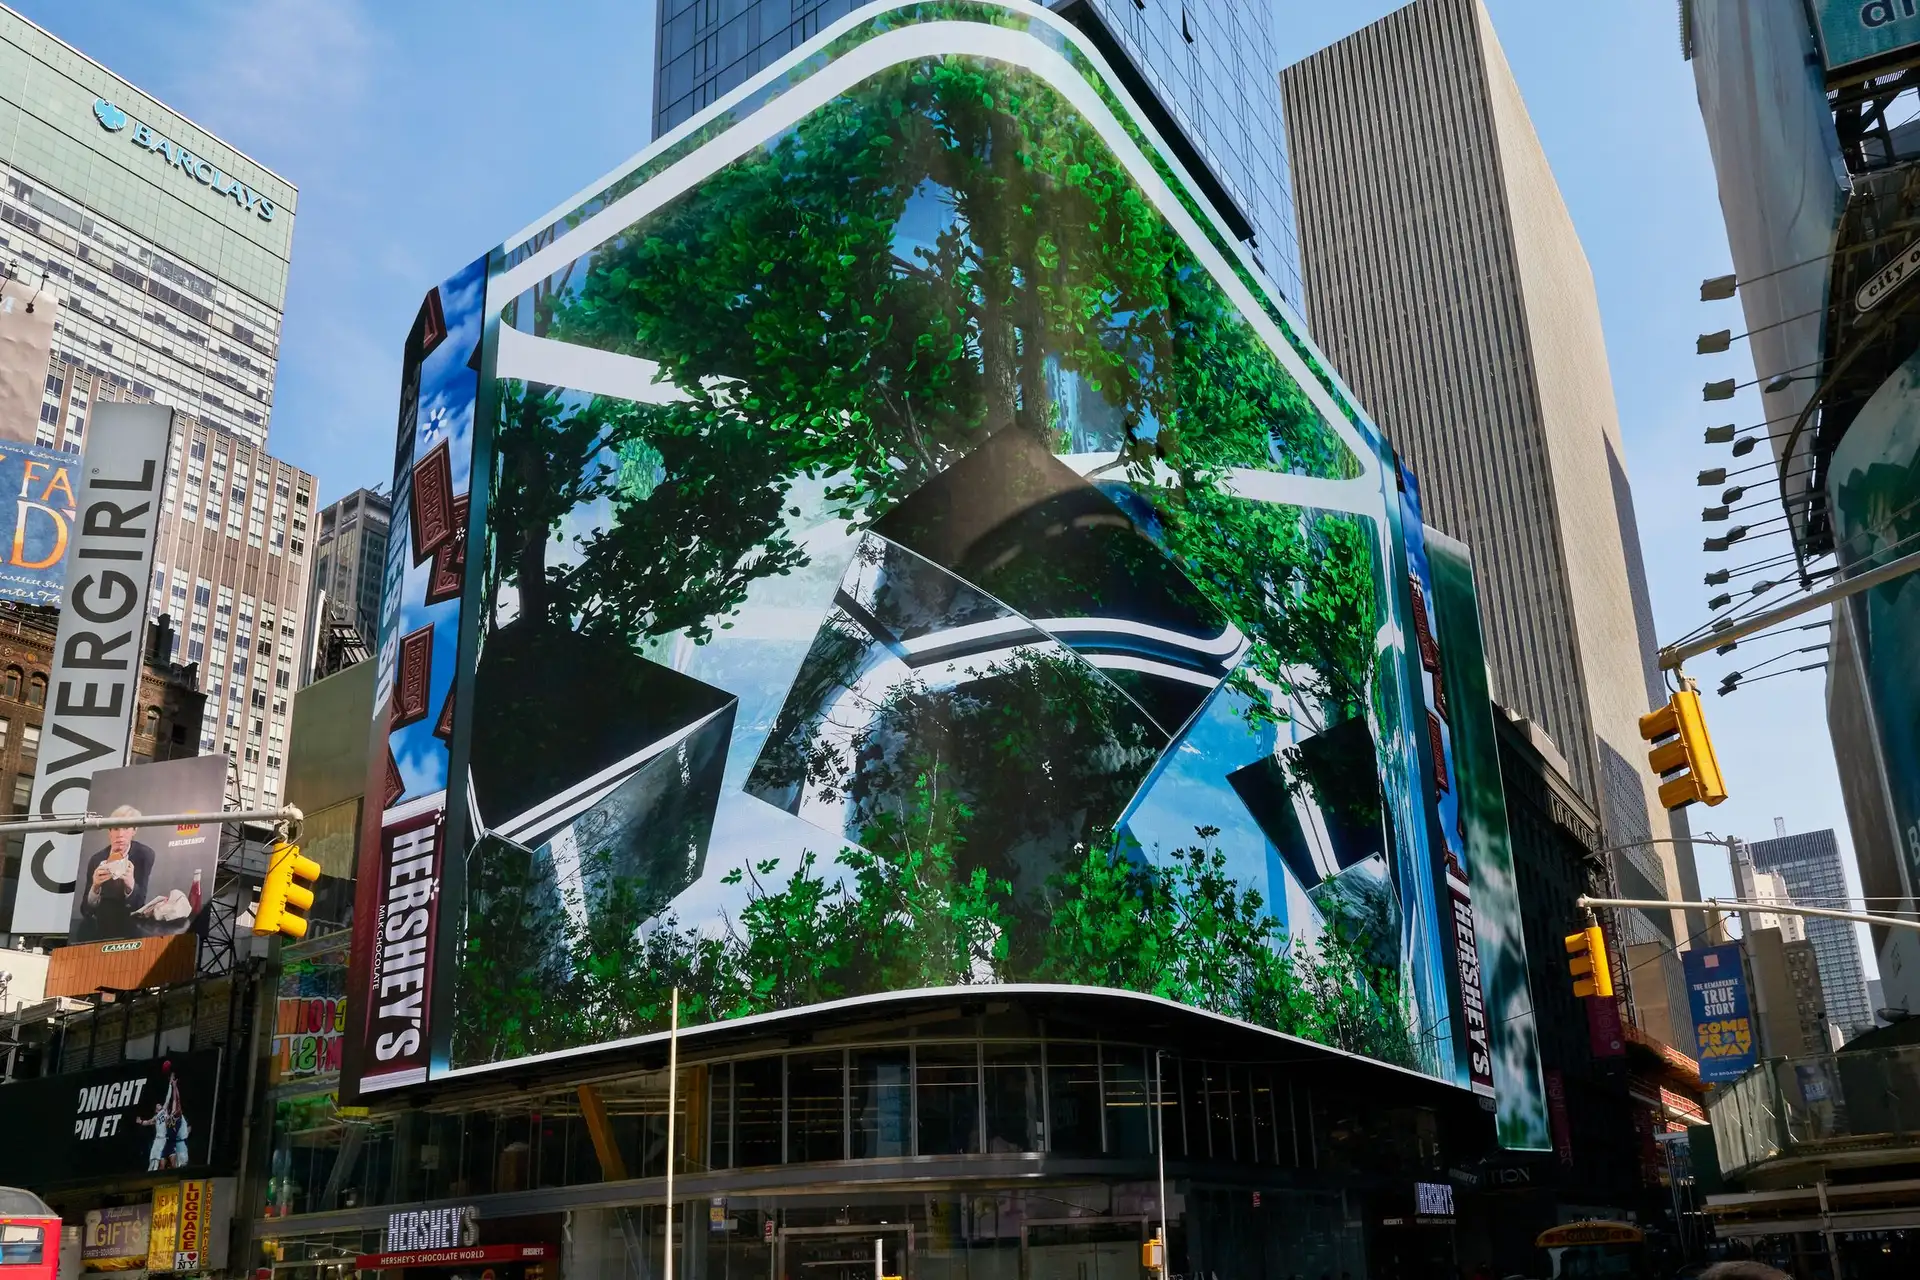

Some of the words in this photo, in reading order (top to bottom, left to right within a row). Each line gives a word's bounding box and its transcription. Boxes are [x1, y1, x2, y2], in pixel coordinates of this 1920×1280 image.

[131, 121, 276, 222] BARCLAYS
[1869, 262, 1905, 297] city
[377, 904, 386, 931] MILK
[105, 942, 138, 951] LAMAR
[376, 824, 435, 1061] HERSHEY'S
[372, 929, 384, 990] CHOCOLATE
[1454, 899, 1490, 1077] HERSHEY'S
[1693, 983, 1704, 991] THE
[1704, 978, 1739, 990] REMARKABLE
[1702, 987, 1736, 1005] TRUE
[1704, 1002, 1736, 1017] STORY
[1698, 1018, 1749, 1035] COME
[1698, 1031, 1752, 1047] FROM
[1700, 1042, 1752, 1060] AWAY
[99, 1114, 122, 1138] ET
[182, 1183, 200, 1250] LUGGAGE
[96, 1221, 142, 1246] GIFTS
[388, 1205, 480, 1252] HERSHEY'S
[201, 1227, 210, 1265] PRICES
[522, 1247, 544, 1256] HERSHEY'S
[177, 1261, 197, 1269] NY
[180, 1253, 185, 1261] I
[381, 1255, 415, 1265] HERSHEY'S
[417, 1252, 458, 1263] CHOCOLATE
[459, 1250, 484, 1260] WORLD
